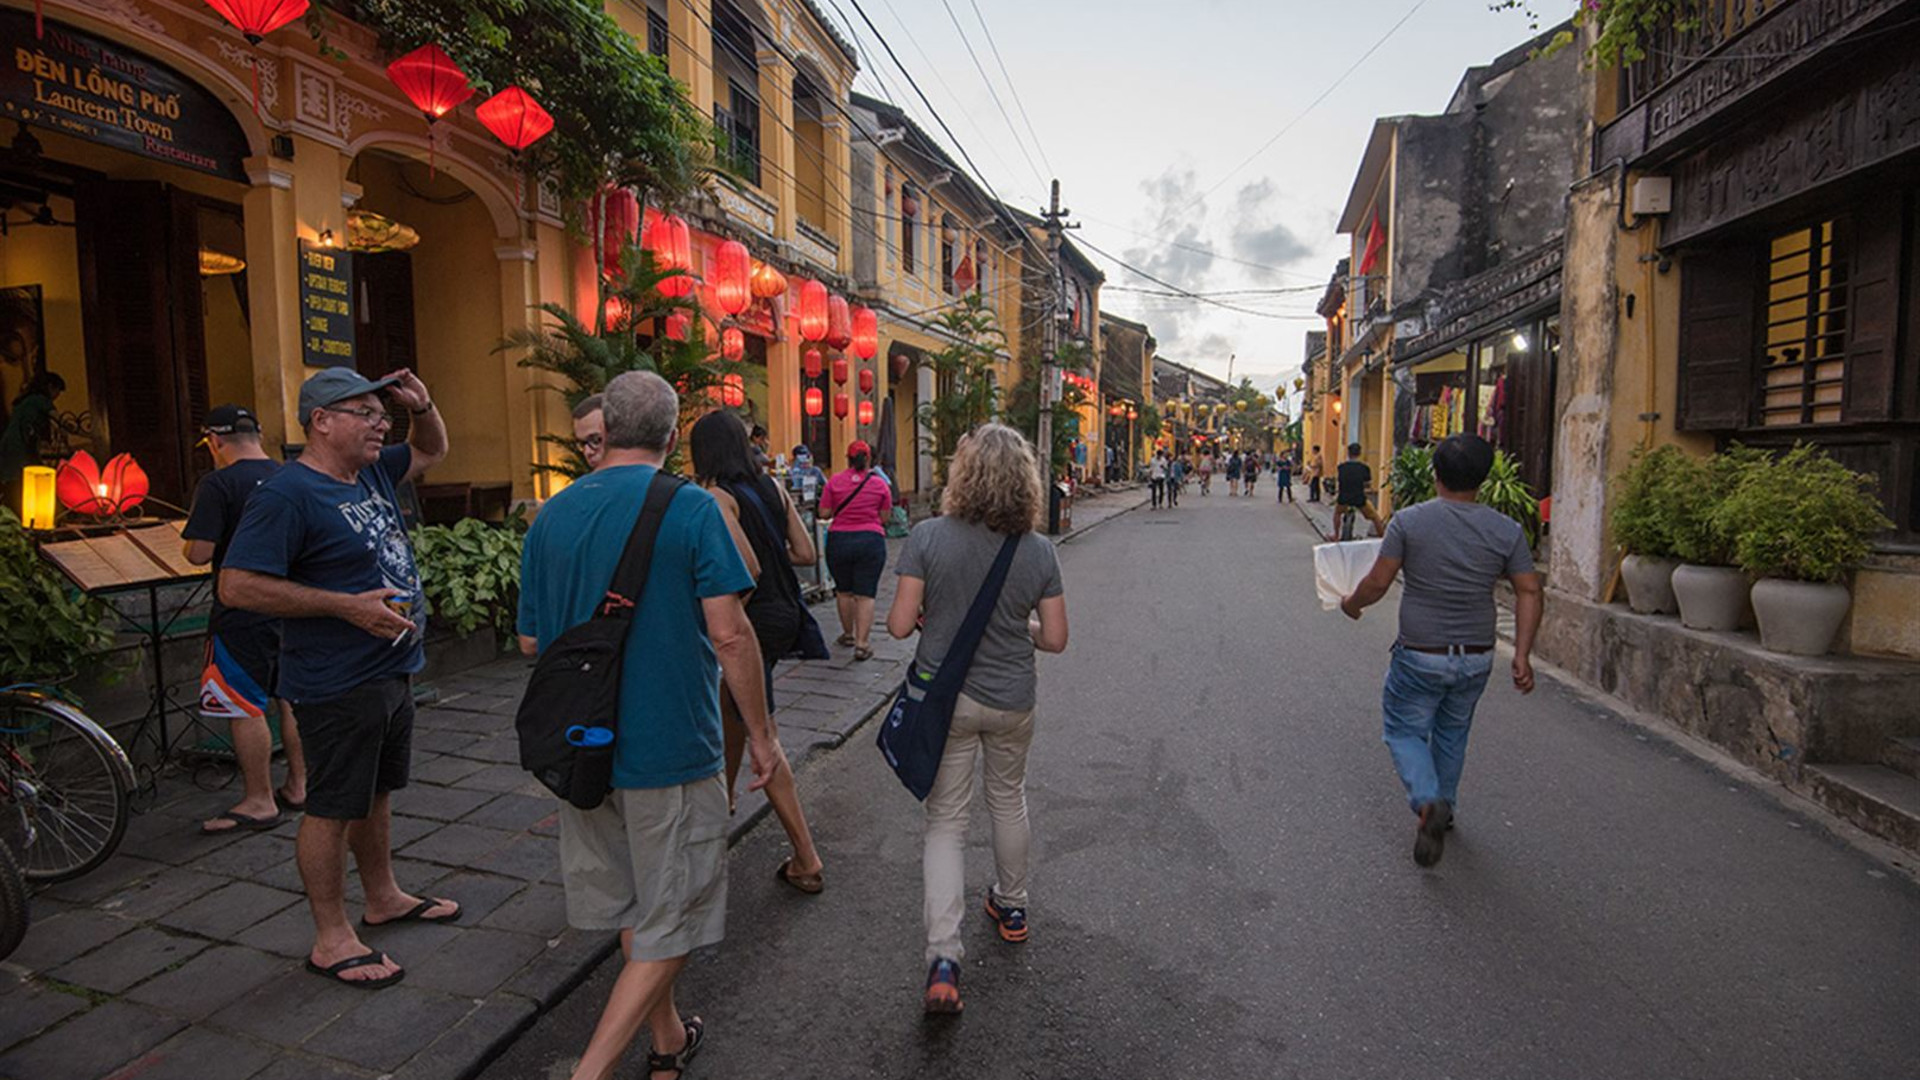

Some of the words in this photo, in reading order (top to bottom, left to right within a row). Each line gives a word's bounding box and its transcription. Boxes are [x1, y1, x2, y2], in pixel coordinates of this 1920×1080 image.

[15, 47, 67, 84] ĐÈN
[73, 63, 136, 106] LỒNG
[33, 78, 119, 126] Lantern
[120, 109, 174, 142] Town
[143, 135, 218, 170] Restaurant
